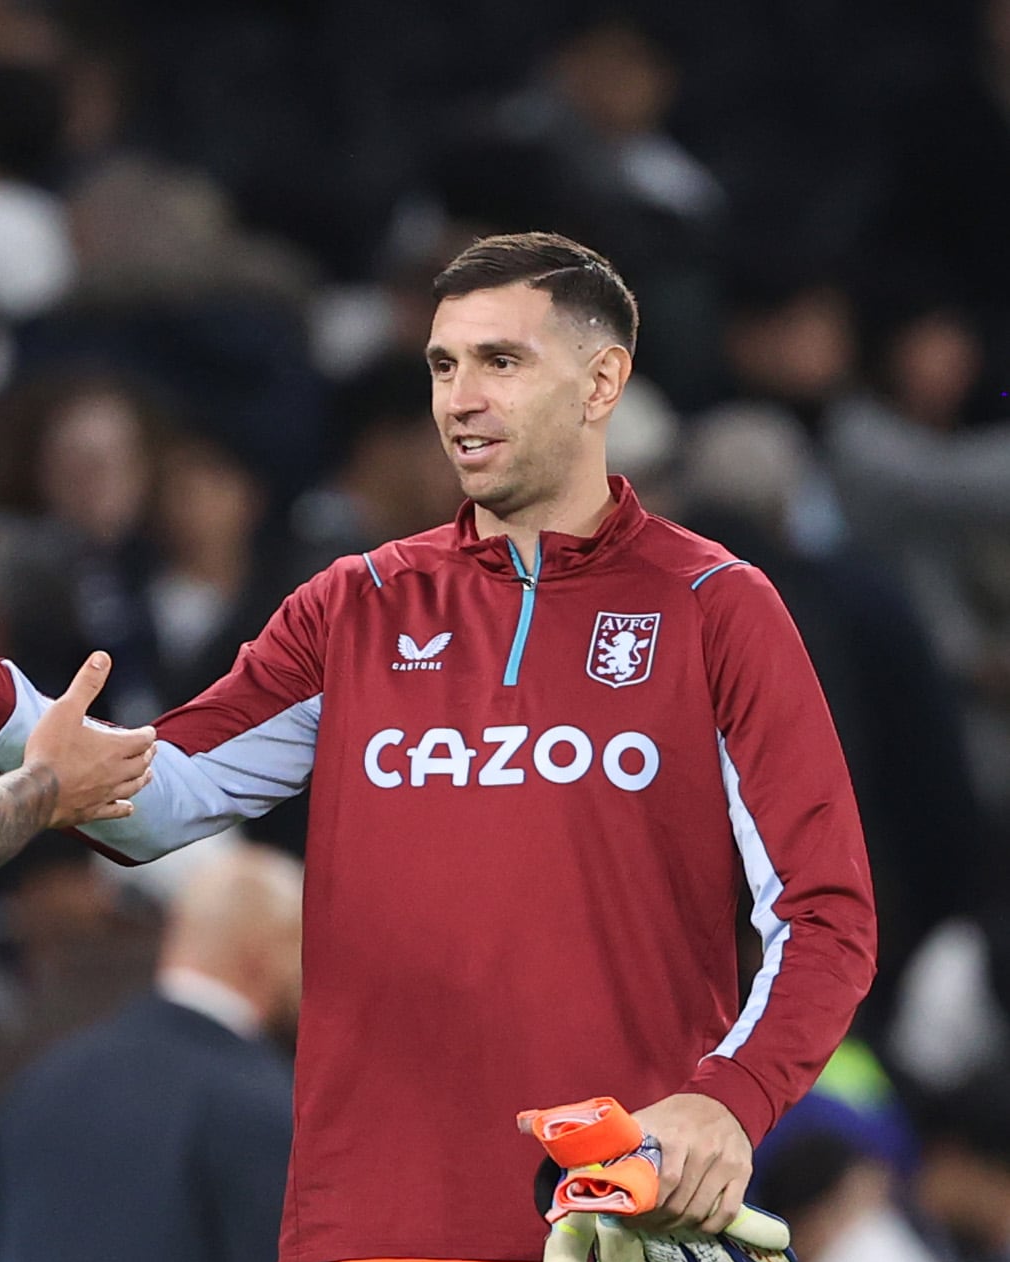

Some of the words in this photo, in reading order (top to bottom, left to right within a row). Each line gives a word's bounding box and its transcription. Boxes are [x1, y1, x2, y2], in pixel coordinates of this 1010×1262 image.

[600, 617, 654, 631] AVFC
[391, 661, 443, 671] CASTORE
[364, 725, 660, 791] CAZOO
